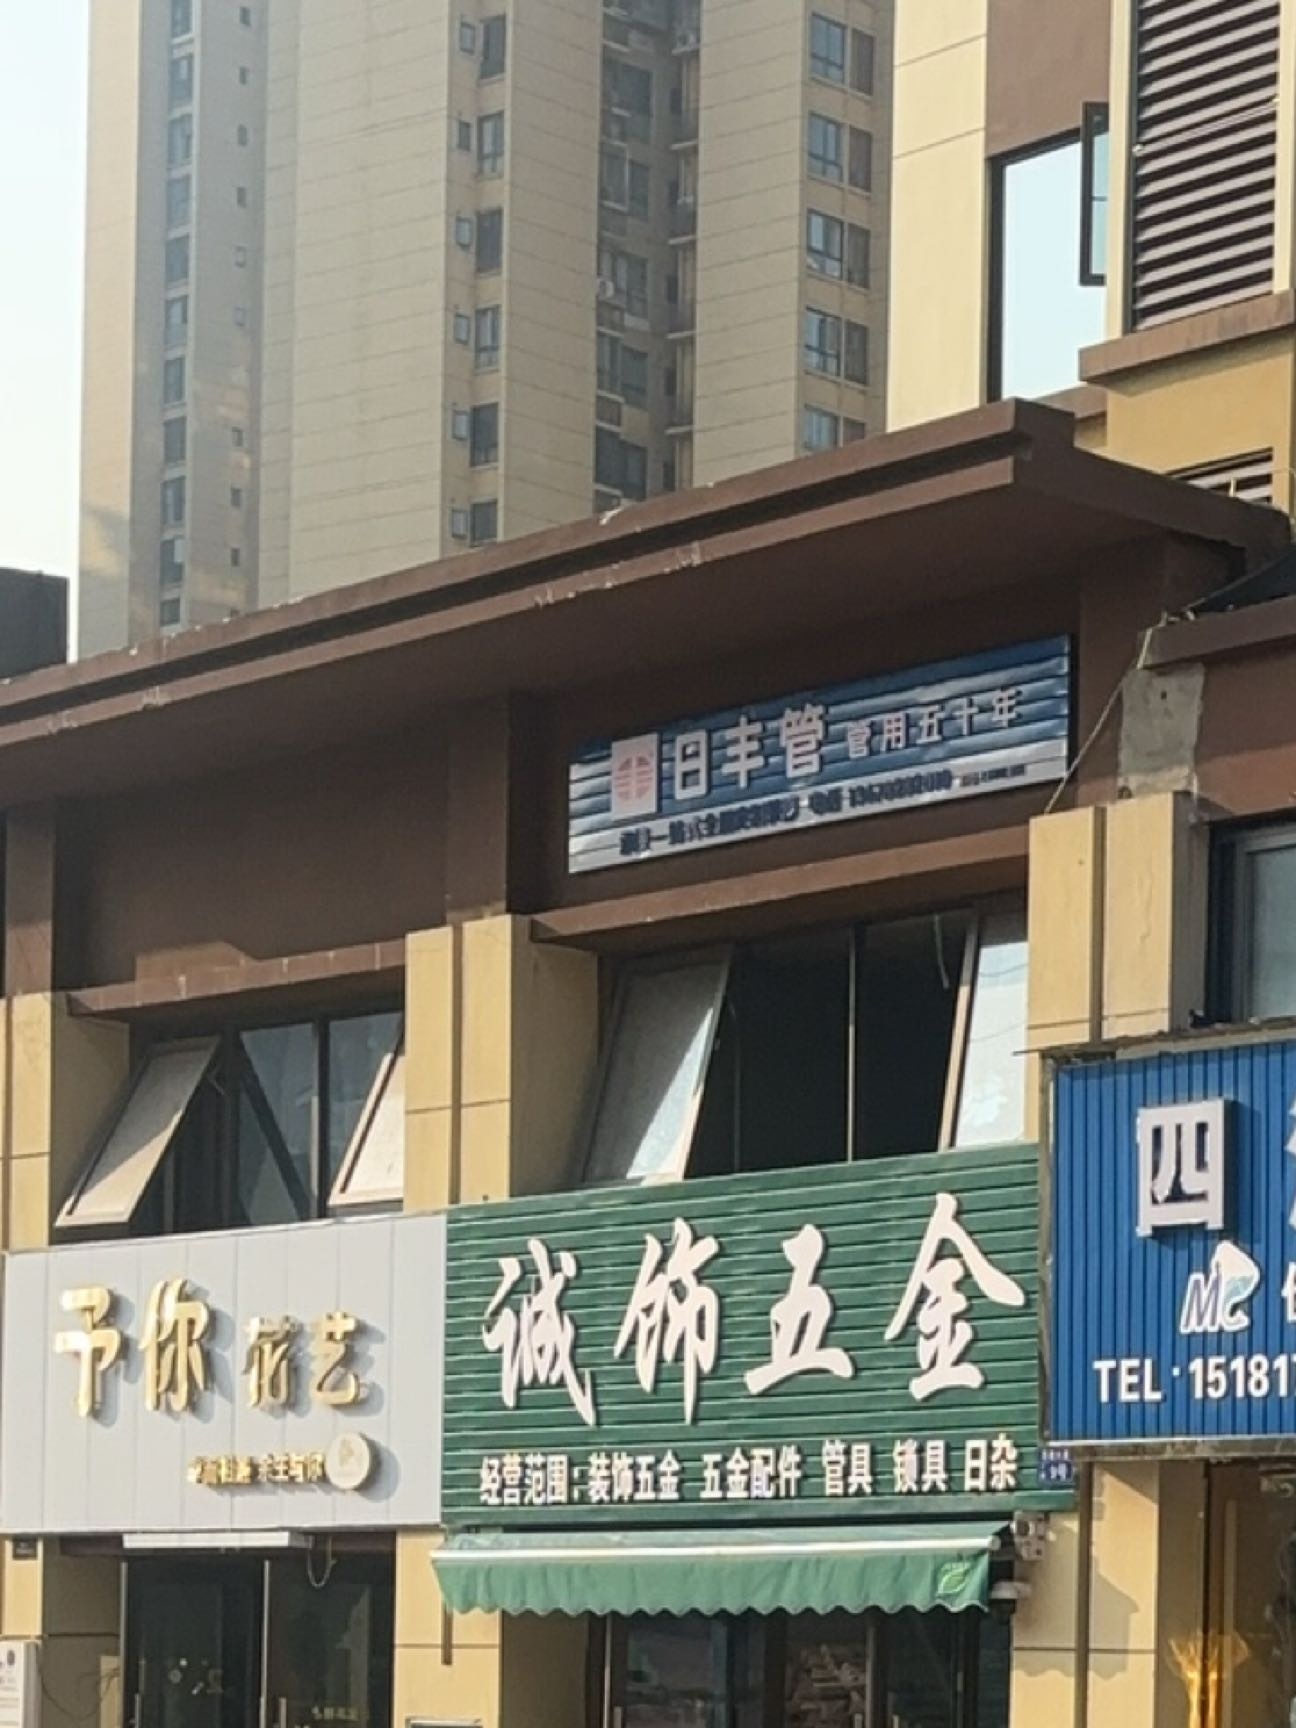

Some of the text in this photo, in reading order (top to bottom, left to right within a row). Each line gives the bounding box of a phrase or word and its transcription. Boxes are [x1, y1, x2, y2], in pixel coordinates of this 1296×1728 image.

[673, 702, 828, 800] 日丰管
[482, 1193, 1025, 1427] 诚饰五金
[700, 1446, 801, 1499] 五金配件
[964, 1432, 1018, 1492] 日杂
